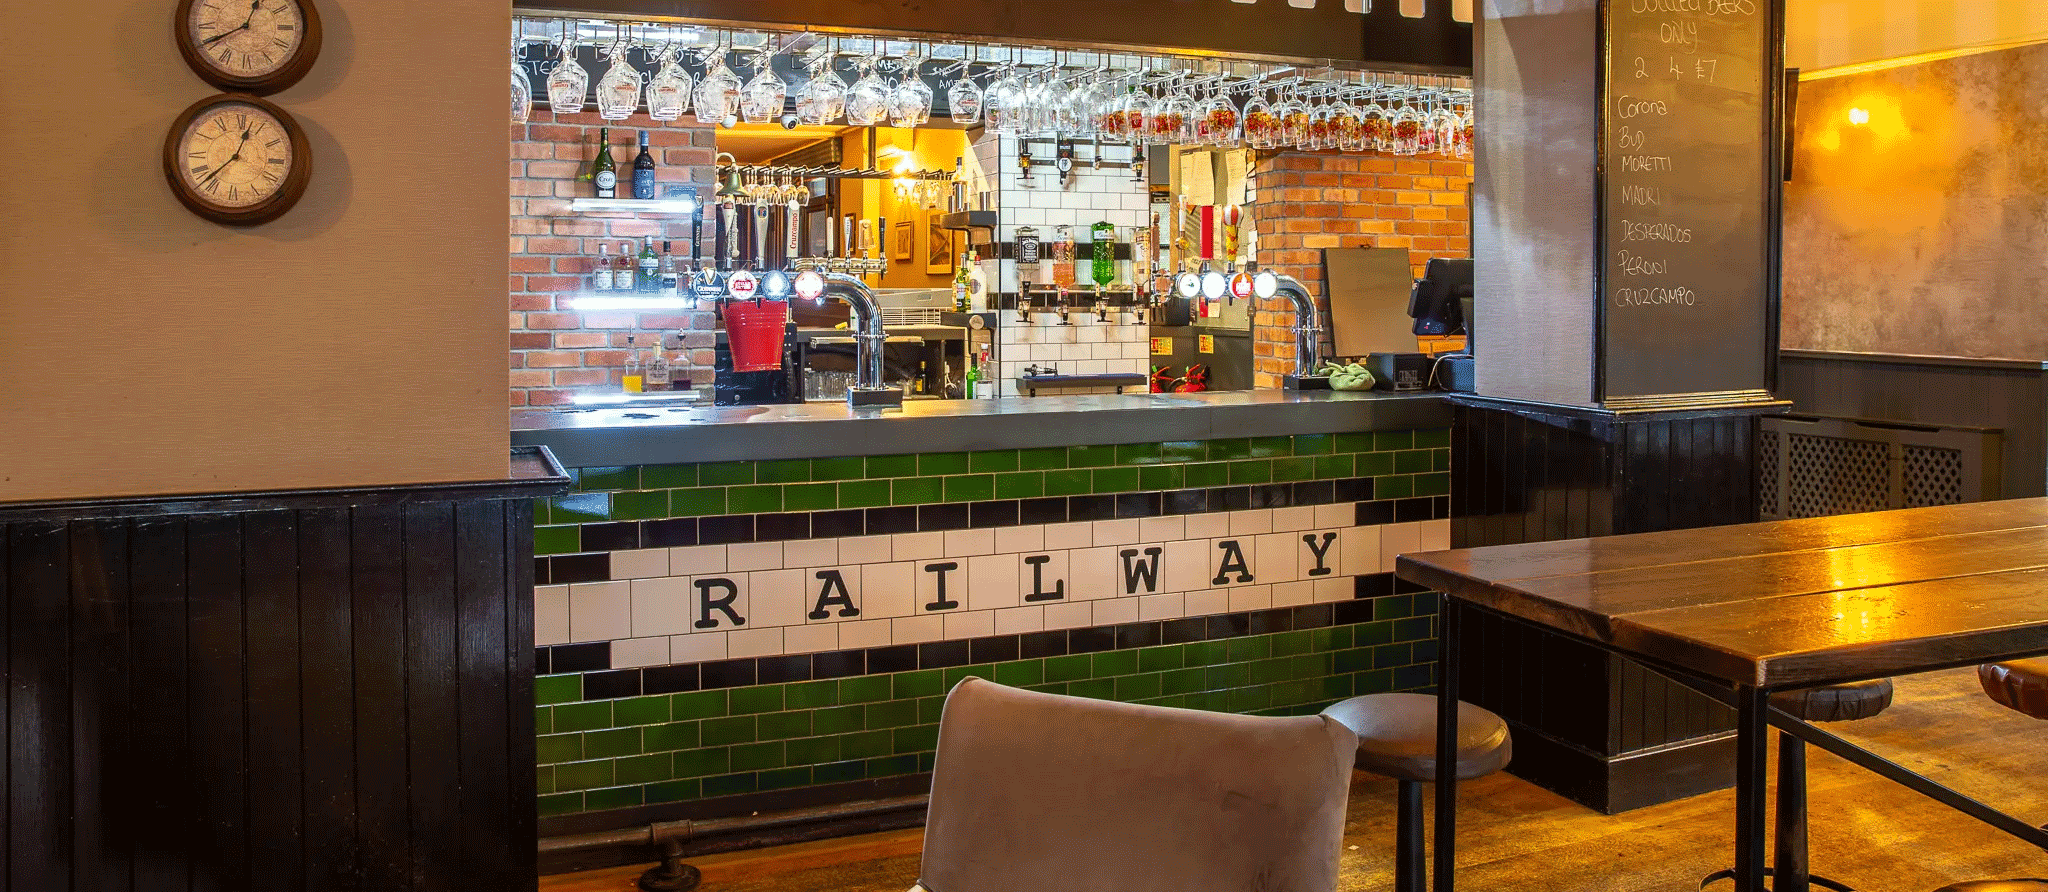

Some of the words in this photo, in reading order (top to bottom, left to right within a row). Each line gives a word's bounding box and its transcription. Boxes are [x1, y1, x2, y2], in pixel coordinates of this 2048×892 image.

[1634, 56, 1649, 79] 2
[1669, 56, 1684, 80] 4
[1618, 94, 1668, 119] Corona
[1622, 155, 1672, 172] MORETTI
[1622, 185, 1661, 206] MADRI
[1621, 219, 1692, 243] DESPERADOS
[1618, 249, 1668, 277] PERONI
[1615, 286, 1696, 307] CRUZCAMPO
[693, 531, 1338, 629] RAILWAY
